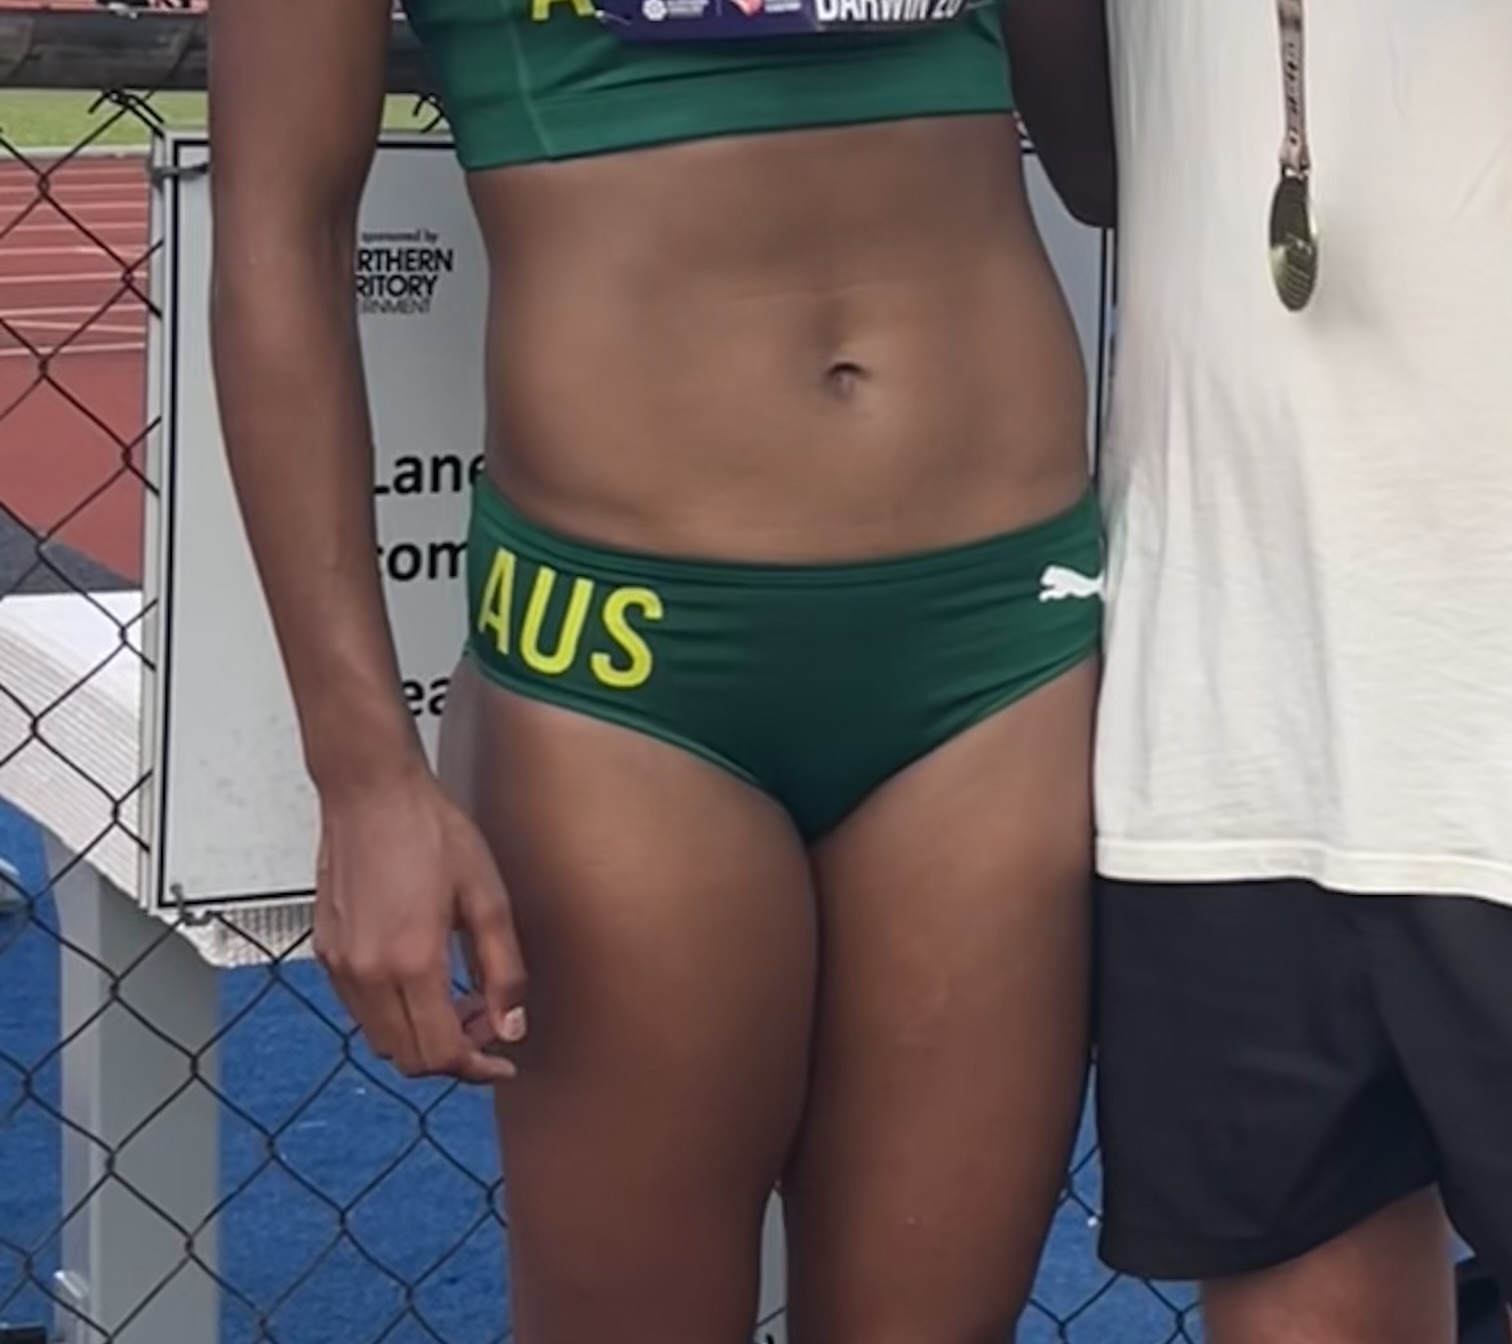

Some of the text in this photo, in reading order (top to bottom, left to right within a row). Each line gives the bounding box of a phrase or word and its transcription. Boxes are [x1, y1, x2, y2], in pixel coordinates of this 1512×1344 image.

[359, 248, 454, 272] RTHERN
[355, 274, 438, 297] RITORY
[377, 540, 468, 581] om
[478, 546, 664, 688] AUS
